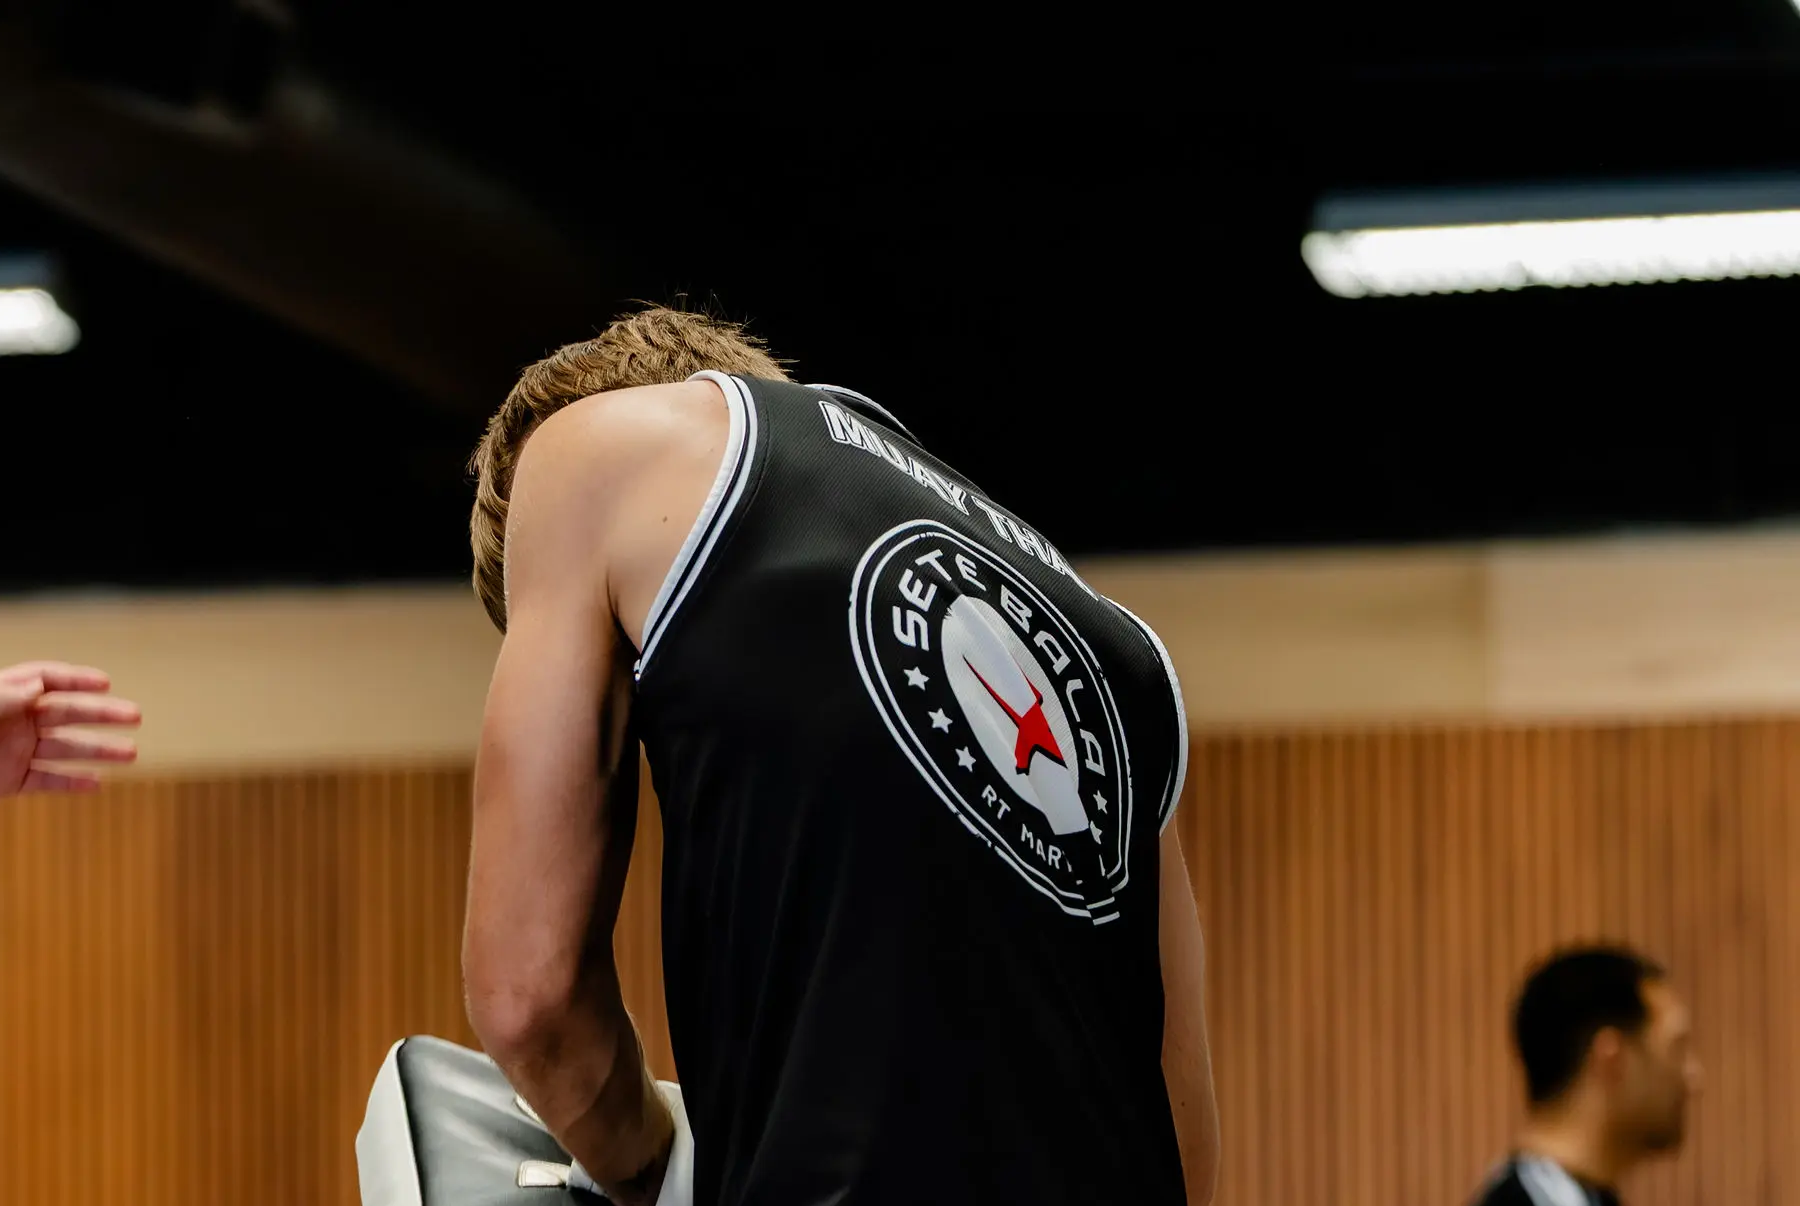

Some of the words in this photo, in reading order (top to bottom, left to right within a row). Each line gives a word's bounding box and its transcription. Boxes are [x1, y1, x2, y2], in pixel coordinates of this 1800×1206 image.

[818, 400, 970, 515] MUAY
[892, 548, 988, 652] SETE
[1000, 583, 1107, 777] BALA
